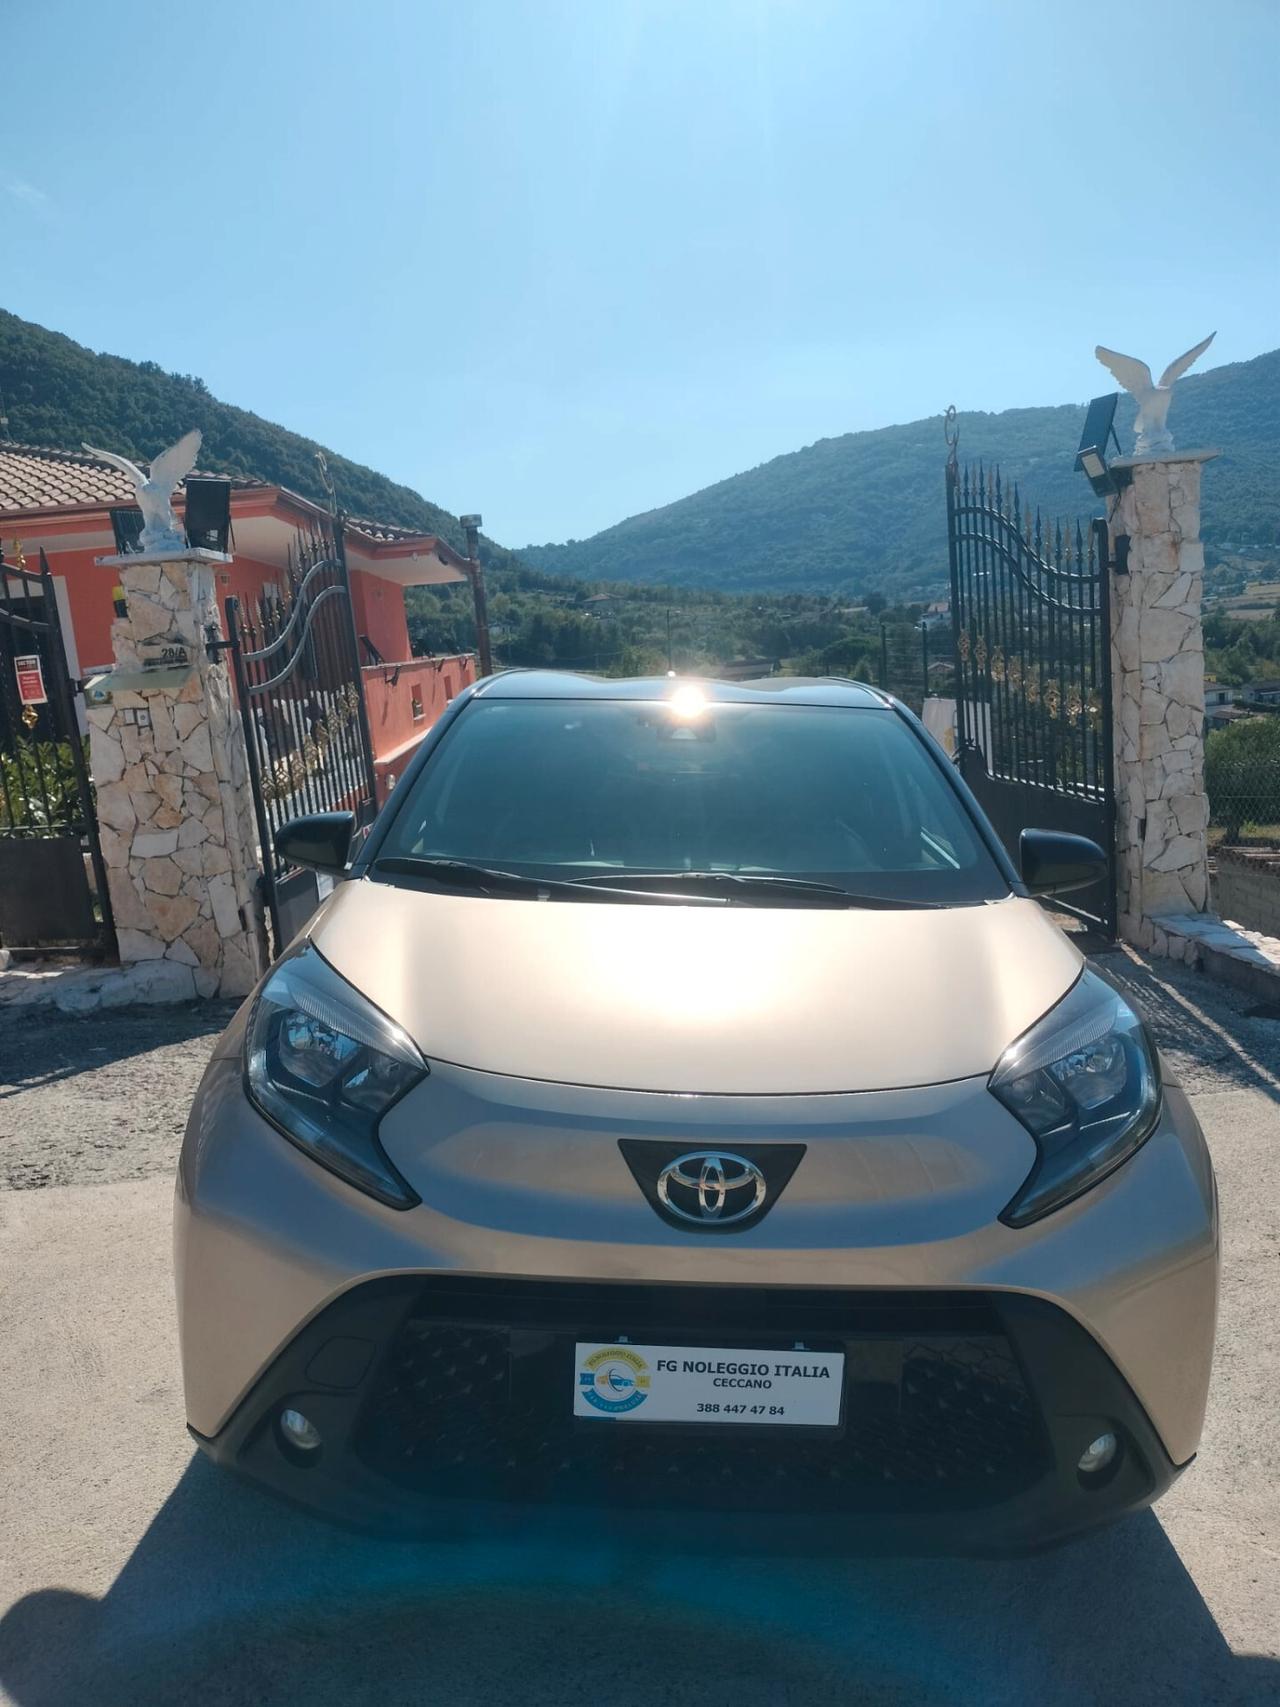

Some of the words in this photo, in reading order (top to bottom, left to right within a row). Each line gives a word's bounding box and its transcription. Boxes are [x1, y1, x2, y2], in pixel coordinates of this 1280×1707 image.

[161, 646, 187, 657] 28/A
[657, 1360, 678, 1373] FG
[683, 1361, 770, 1376] NOLEGGIO
[774, 1364, 830, 1378] ITALIA
[713, 1378, 772, 1389] CECCANO
[696, 1403, 720, 1413] 388
[723, 1404, 746, 1414] 447
[749, 1405, 766, 1415] 47
[768, 1406, 785, 1416] 84
